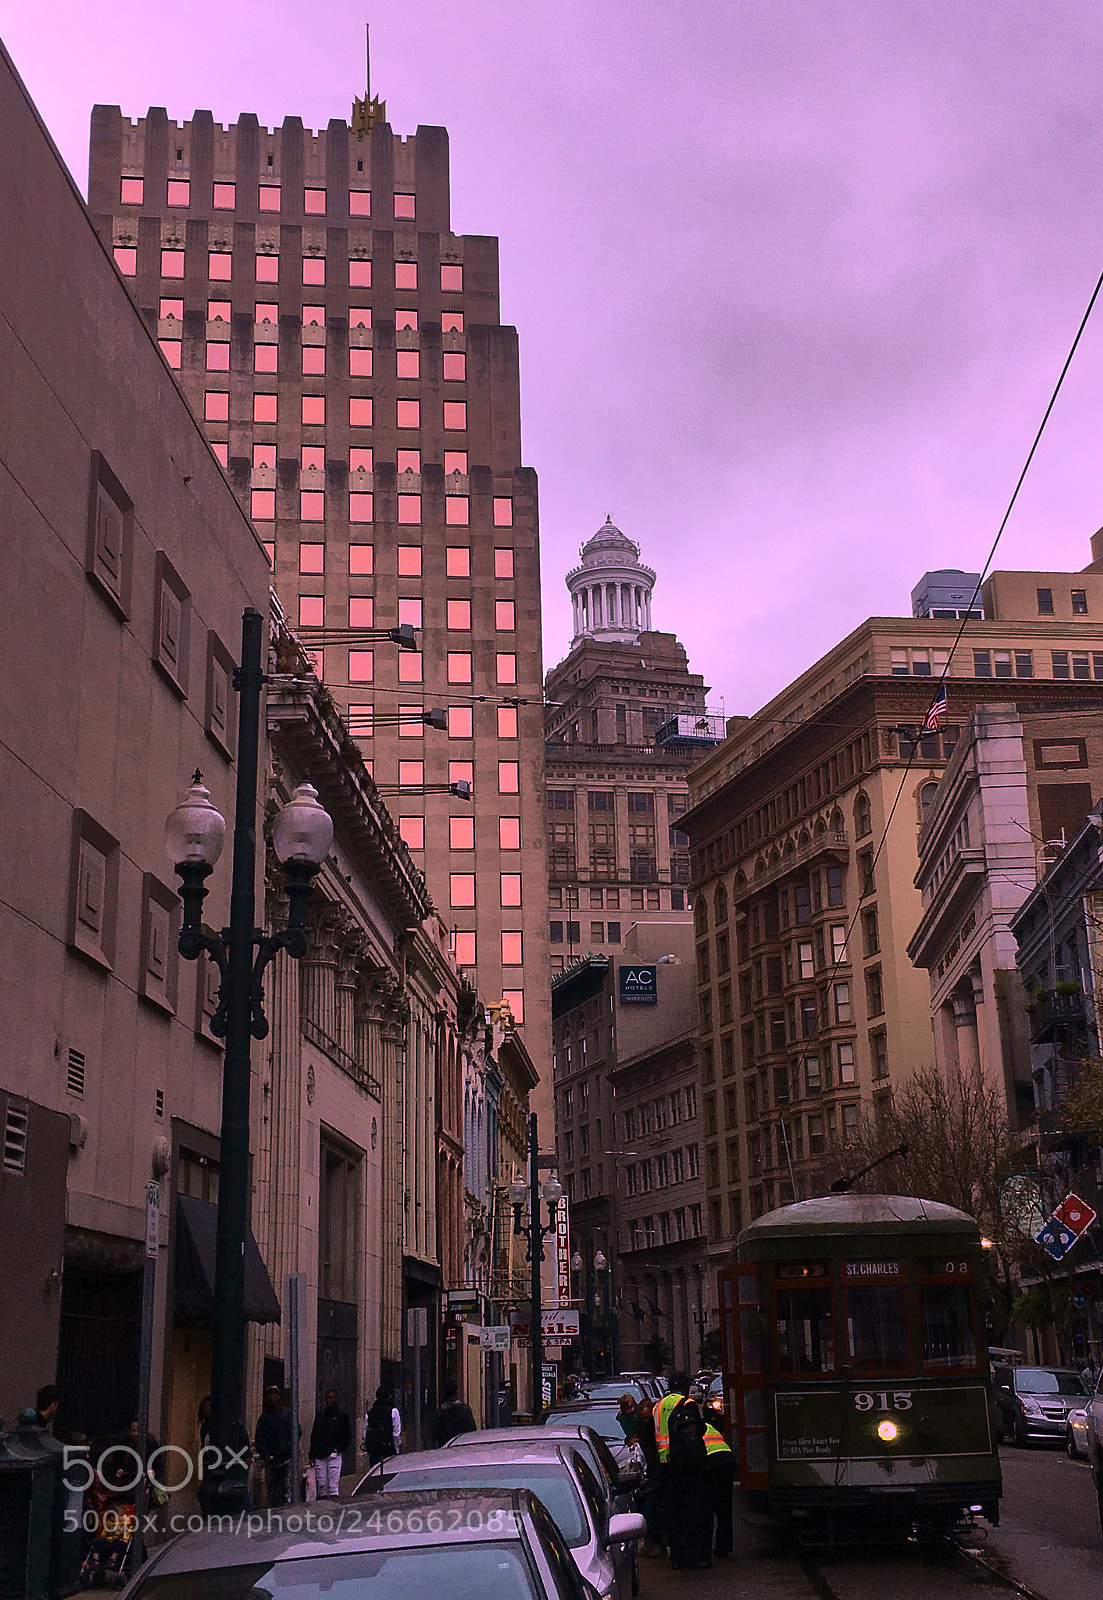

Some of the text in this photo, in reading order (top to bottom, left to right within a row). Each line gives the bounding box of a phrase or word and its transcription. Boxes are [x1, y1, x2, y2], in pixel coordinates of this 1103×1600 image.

[625, 970, 652, 984] AC
[557, 1197, 569, 1307] BROTHER'S
[846, 1262, 899, 1275] ST. CHARLES
[555, 1338, 572, 1346] SPA
[854, 1392, 913, 1411] 915
